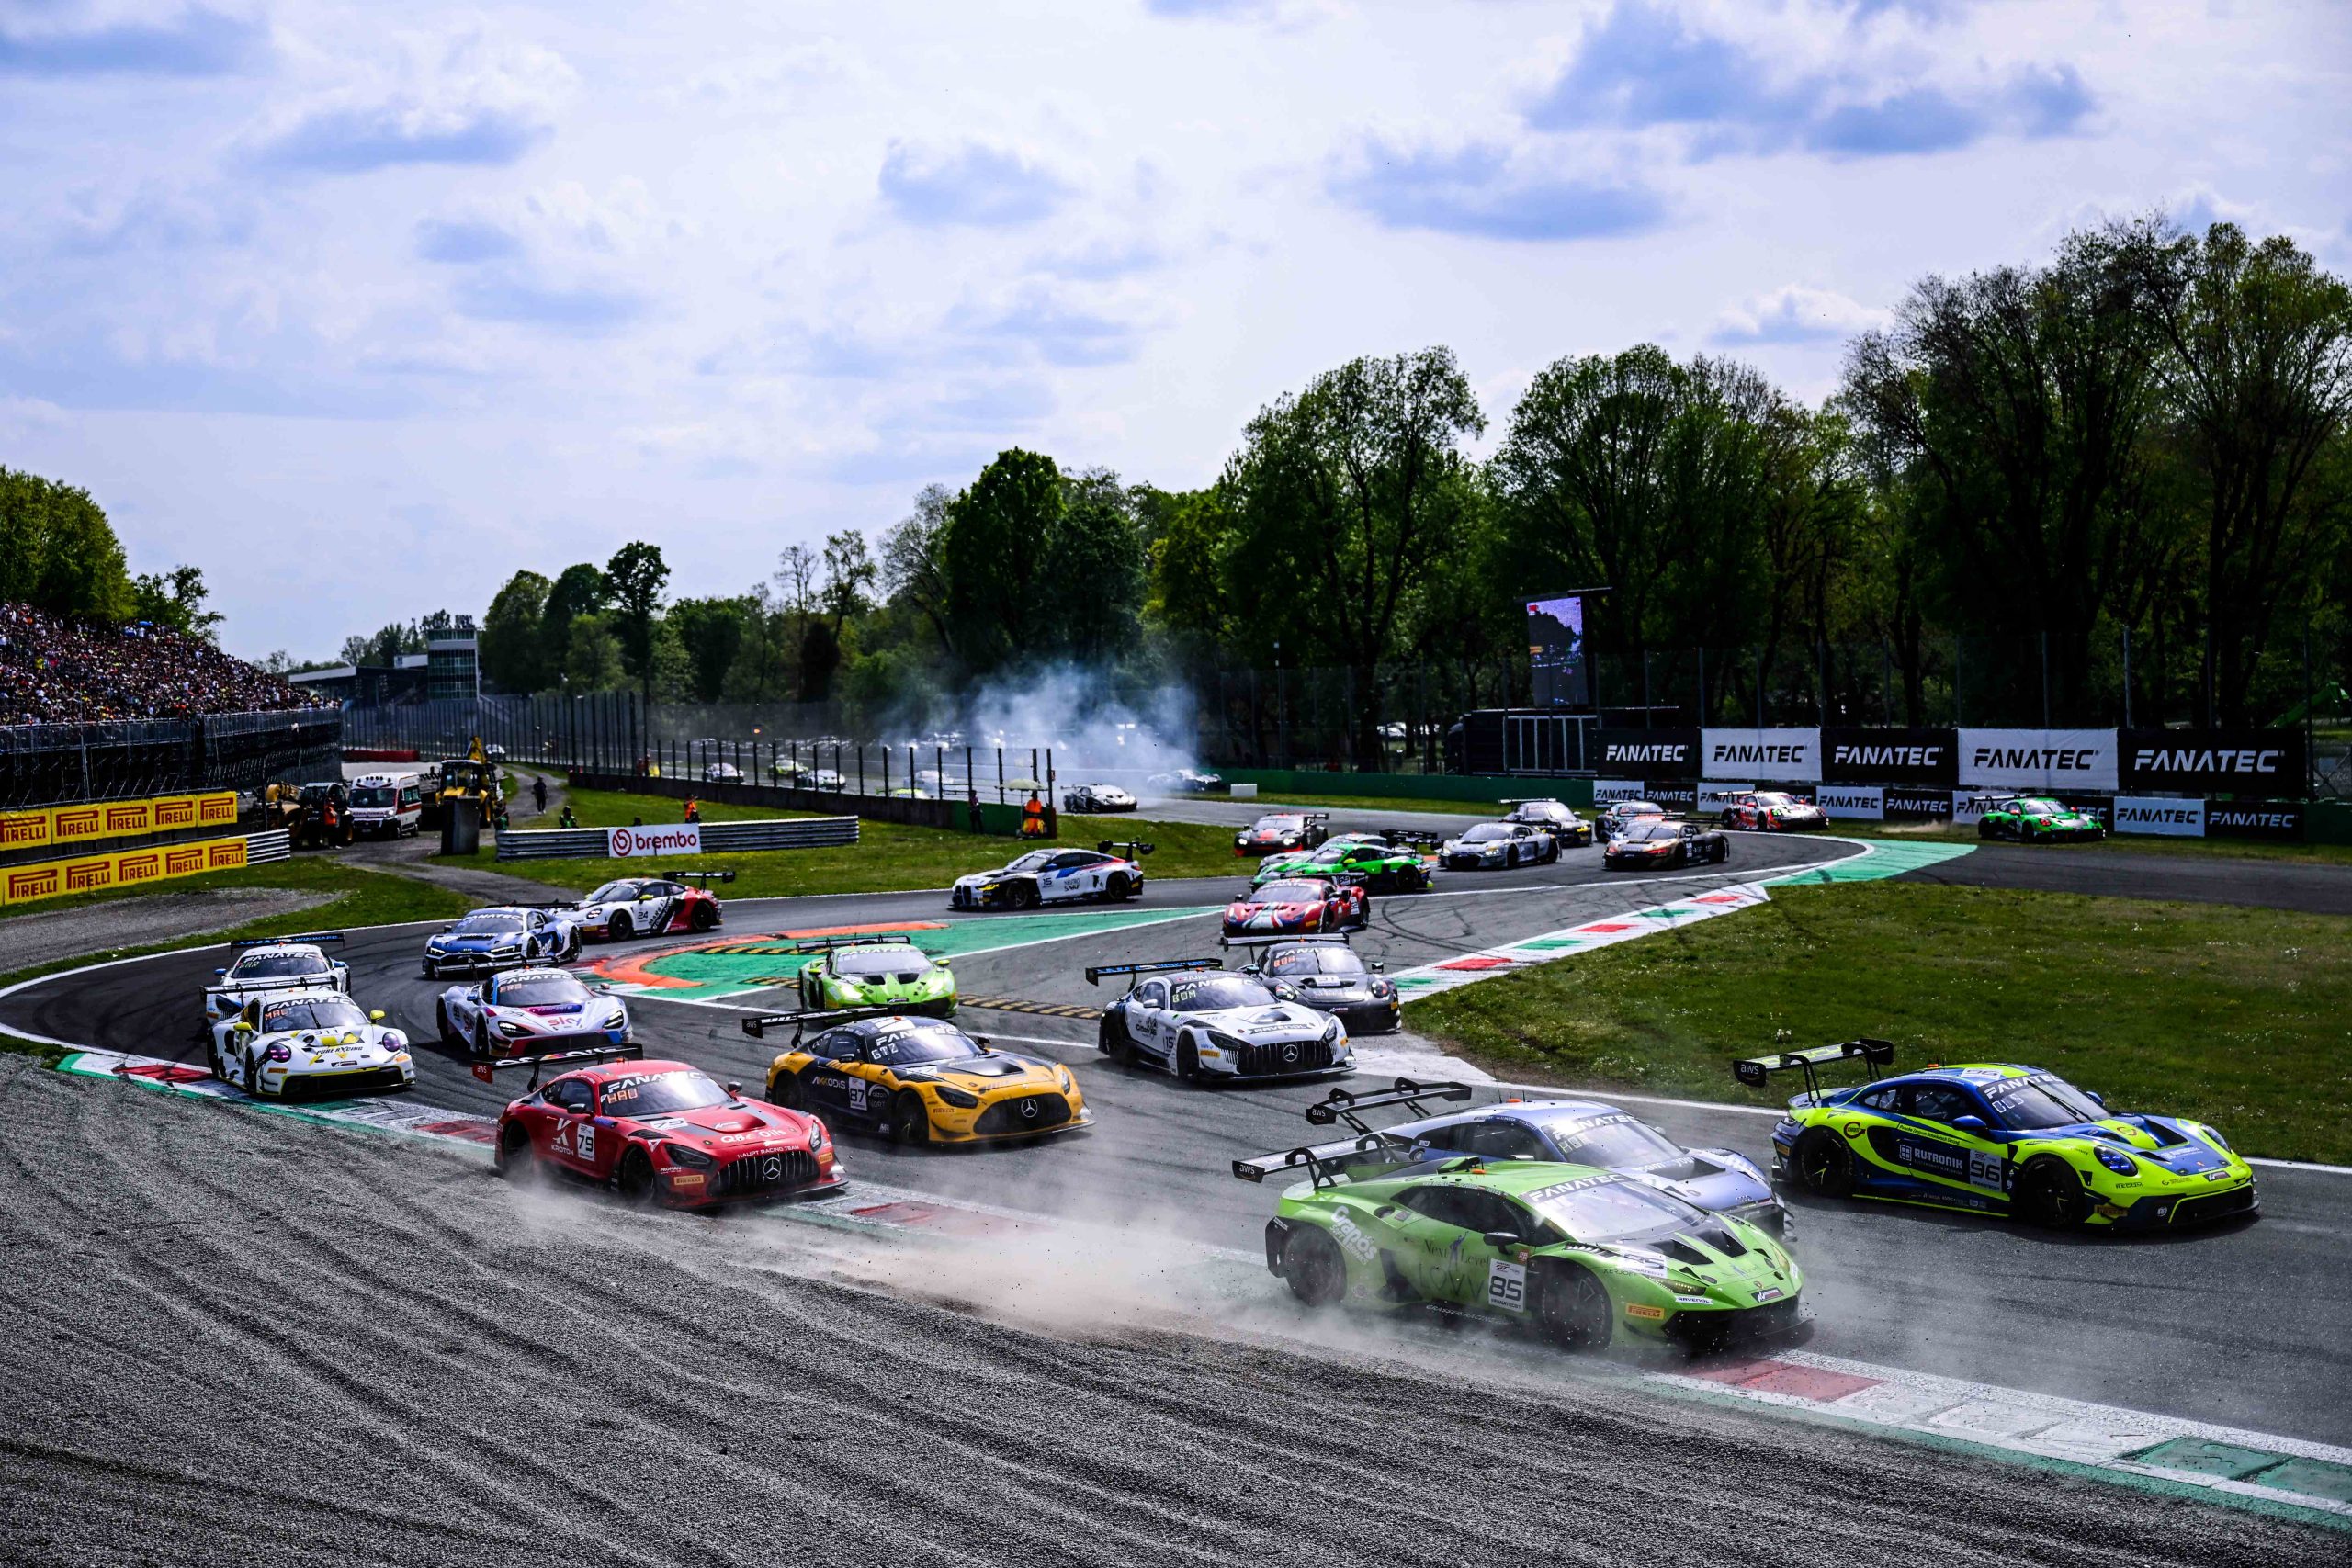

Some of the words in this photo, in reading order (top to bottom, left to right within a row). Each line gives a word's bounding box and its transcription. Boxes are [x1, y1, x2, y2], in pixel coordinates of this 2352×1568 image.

[1606, 745, 1687, 762] FANATEC
[1713, 745, 1805, 763] FANATEC
[1834, 746, 1940, 766] FANATEC
[1974, 749, 2095, 771] FANATEC
[2134, 750, 2280, 773] FANATEC
[1595, 789, 1642, 801] FANATEC
[1645, 790, 1694, 801] FANATEC
[1818, 796, 1880, 809] FANATEC
[155, 801, 193, 825] PIRELLI
[200, 797, 234, 820] PIRELLI
[1886, 798, 1949, 812] FANATEC
[56, 810, 99, 837] PIRELLI
[107, 806, 147, 831] PIRELLI
[2116, 808, 2199, 824] FANATEC
[2209, 812, 2295, 828] FANATEC
[0, 816, 46, 843] PIRELLI
[636, 831, 697, 850] brembo
[165, 849, 203, 874] PIRELLI
[209, 843, 243, 867] PIRELLI
[66, 861, 111, 890] PIRELLI
[119, 854, 159, 882] PIRELLI
[9, 869, 58, 899] PIRELLI
[243, 953, 313, 964] FANATEC
[268, 998, 351, 1011] FANATEC
[548, 1017, 582, 1027] sky
[1741, 1064, 1759, 1075] aws
[850, 1089, 865, 1103] 87
[1984, 1075, 2063, 1100] FANATEC
[1312, 1108, 1326, 1117] aws
[759, 1128, 787, 1139] Oils
[551, 1144, 574, 1156] KROTON
[578, 1134, 594, 1153] 79
[737, 1150, 760, 1158] HAUPT
[761, 1146, 783, 1155] RACING
[1914, 1148, 1962, 1169] RUTRONIK
[1239, 1164, 1255, 1175] aws
[1971, 1160, 2001, 1182] 96
[1530, 1174, 1626, 1201] FANATEC
[1461, 1249, 1489, 1269] Level
[1489, 1276, 1523, 1302] 85
[1628, 1305, 1662, 1318] PIRELLI
